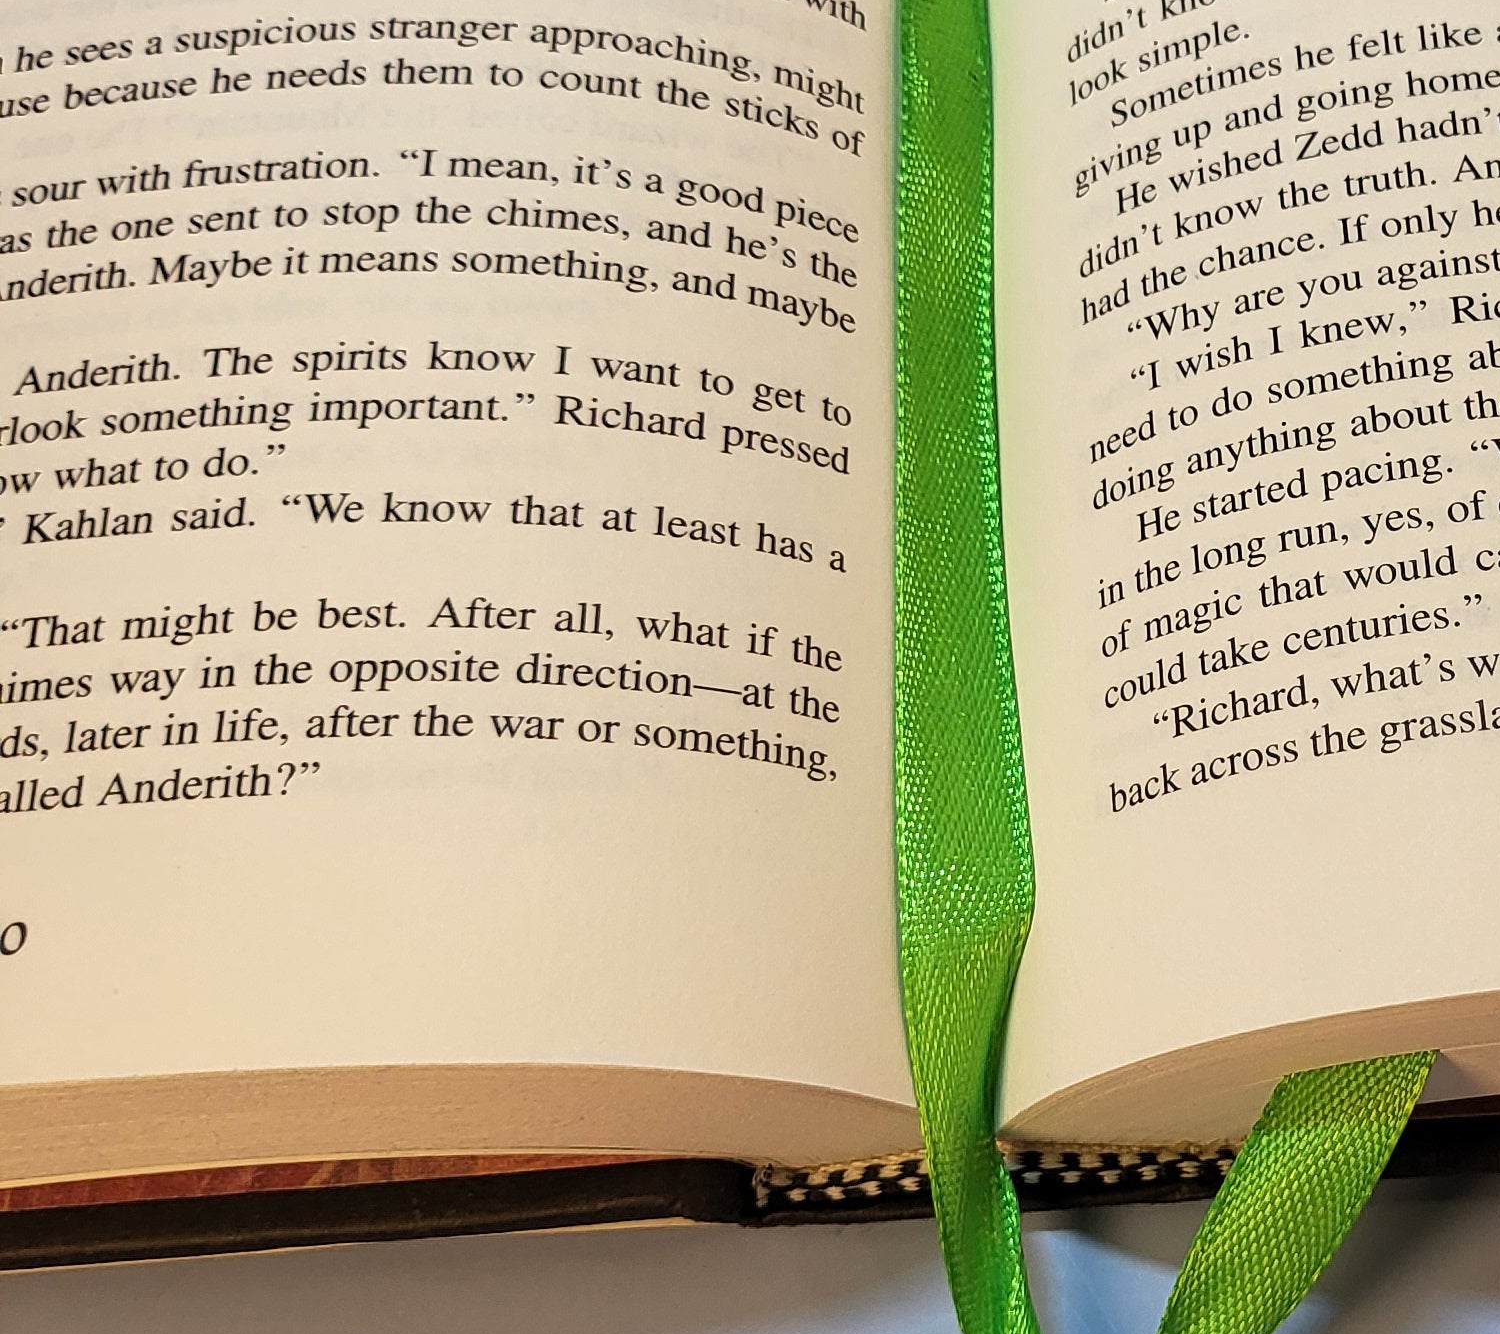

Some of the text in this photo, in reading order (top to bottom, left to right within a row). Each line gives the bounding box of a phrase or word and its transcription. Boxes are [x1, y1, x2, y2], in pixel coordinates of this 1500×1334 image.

[1109, 54, 1284, 128] Sometimes
[1294, 44, 1335, 72] he
[1347, 29, 1407, 62] felt
[1416, 21, 1483, 52] like
[12, 340, 852, 427] Anderith. The spirits know I want to get to
[21, 491, 847, 574] Kahlan said. “We know that at least has a
[0, 596, 843, 672] “That might be best. After all, what if the
[1153, 673, 1320, 739] “Richard,
[1329, 652, 1456, 699] what’s
[1109, 762, 1182, 813] back
[1191, 739, 1299, 786] across
[1309, 722, 1368, 758] the
